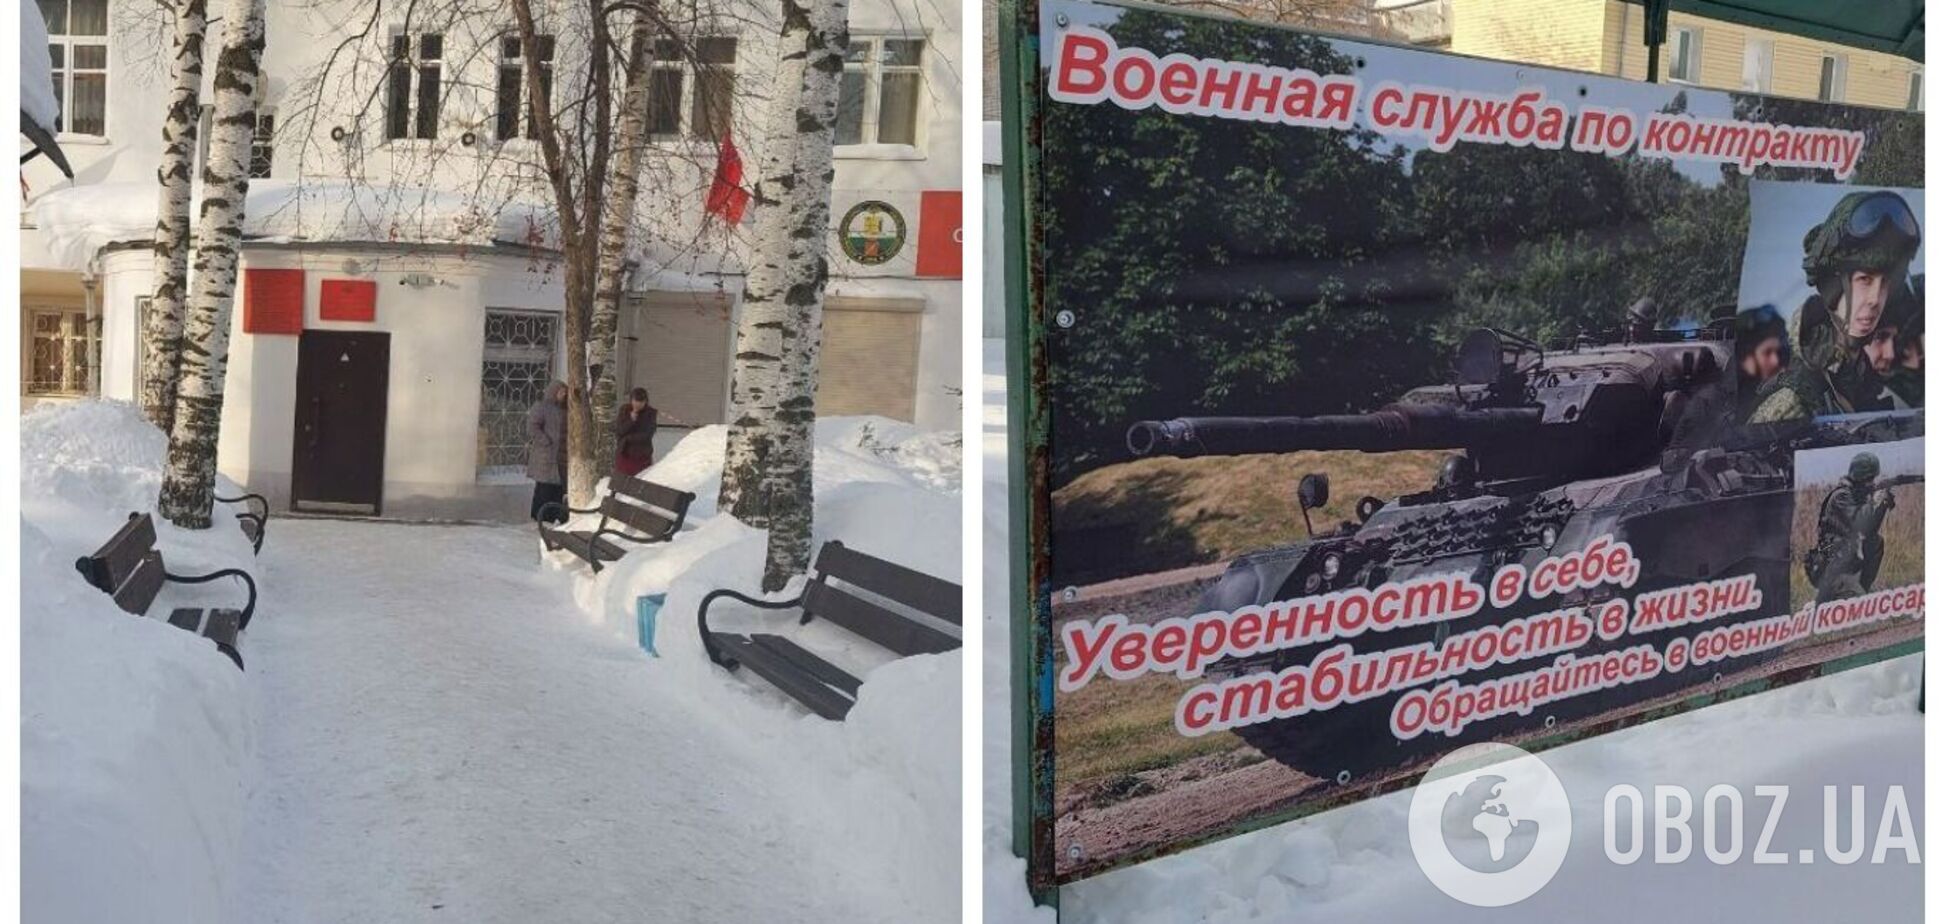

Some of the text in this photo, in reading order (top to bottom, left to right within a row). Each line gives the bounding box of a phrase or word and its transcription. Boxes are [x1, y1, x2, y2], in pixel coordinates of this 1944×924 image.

[1057, 34, 1861, 174] Военная служба по контракту
[1067, 540, 1635, 683] Уверенность в себе,
[1182, 580, 1759, 730] стабильность в жизни.
[1396, 649, 1660, 733] Обращайтесь
[1667, 643, 1687, 668] в
[1693, 605, 1811, 660] военный
